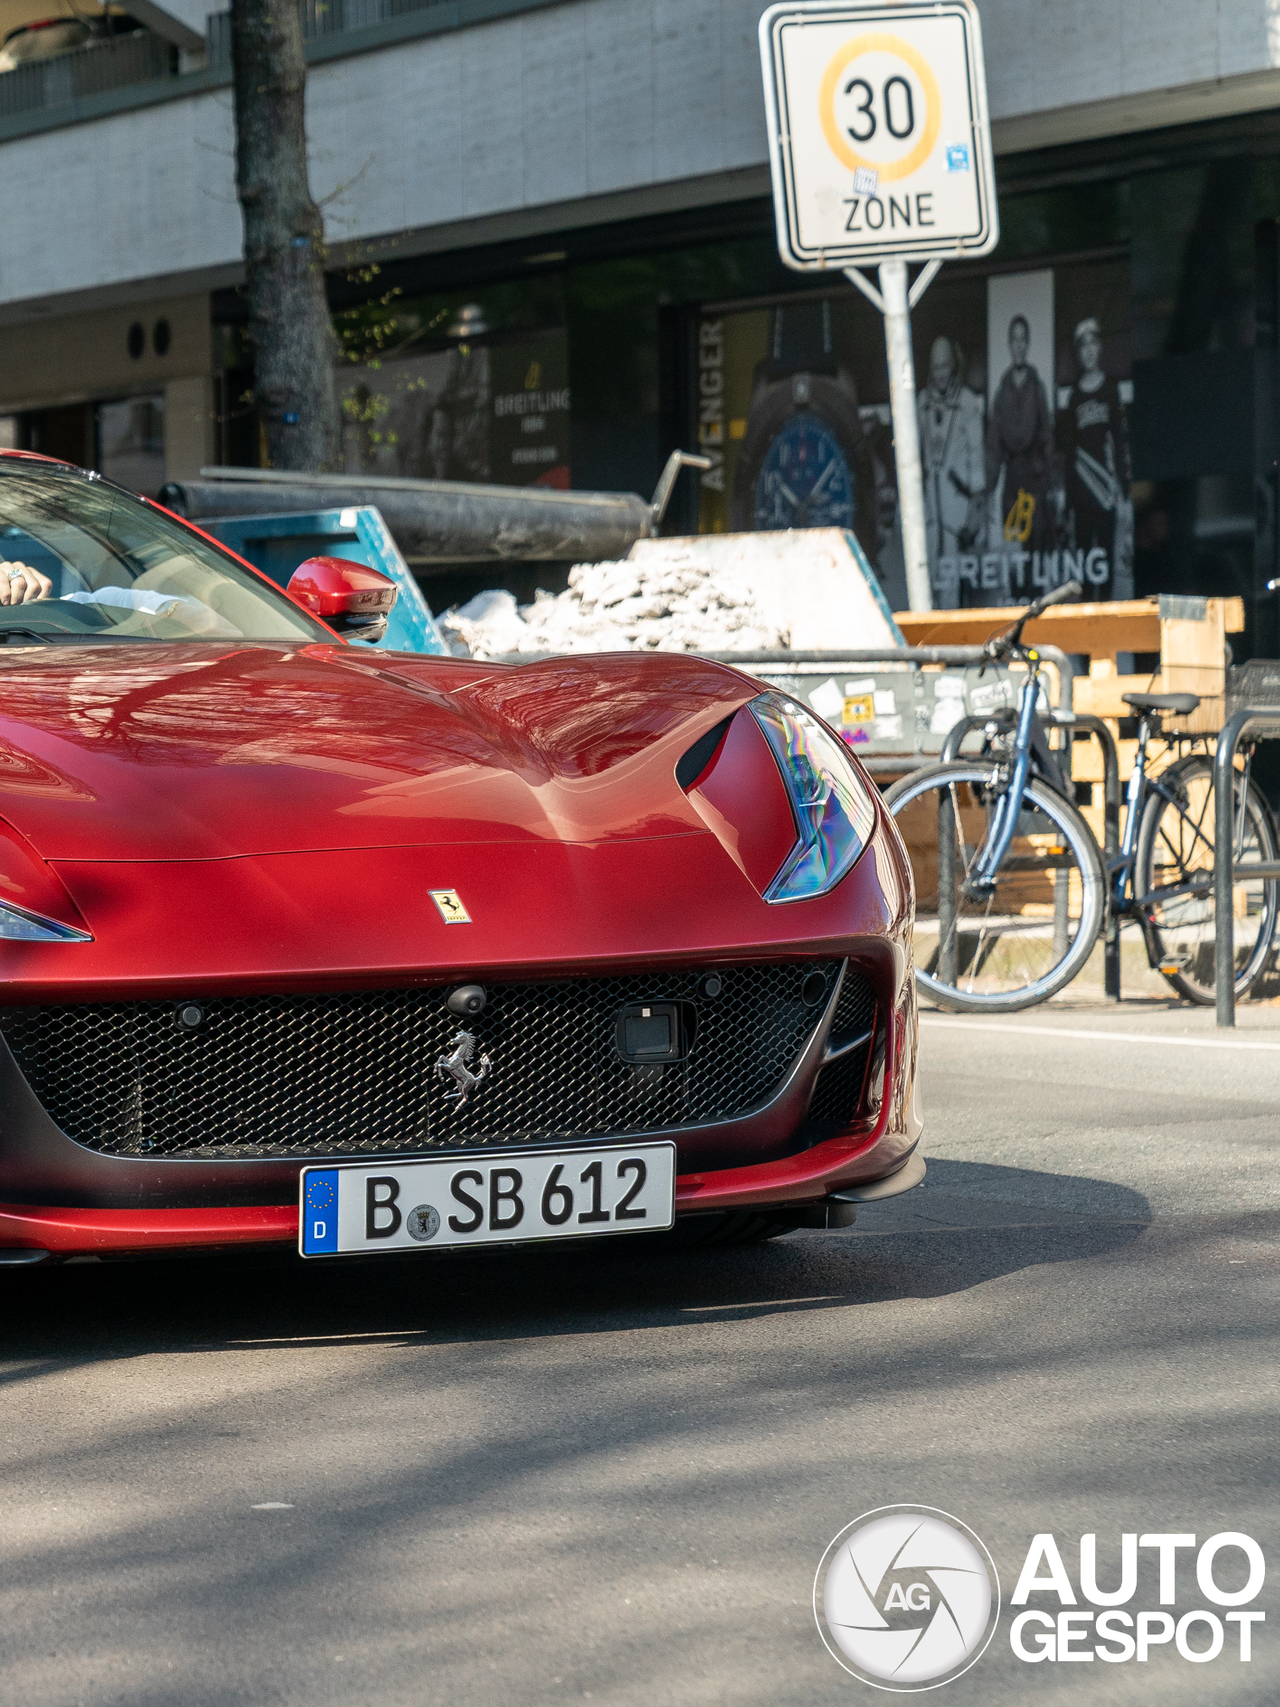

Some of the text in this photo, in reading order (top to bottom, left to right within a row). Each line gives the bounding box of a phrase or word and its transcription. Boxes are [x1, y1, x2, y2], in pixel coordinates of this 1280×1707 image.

[845, 76, 914, 142] 30
[843, 193, 935, 232] ZONE
[700, 319, 724, 491] AVENGER
[314, 1221, 326, 1239] D
[365, 1176, 401, 1239] B
[448, 1168, 524, 1233] SB
[541, 1158, 647, 1226] 612
